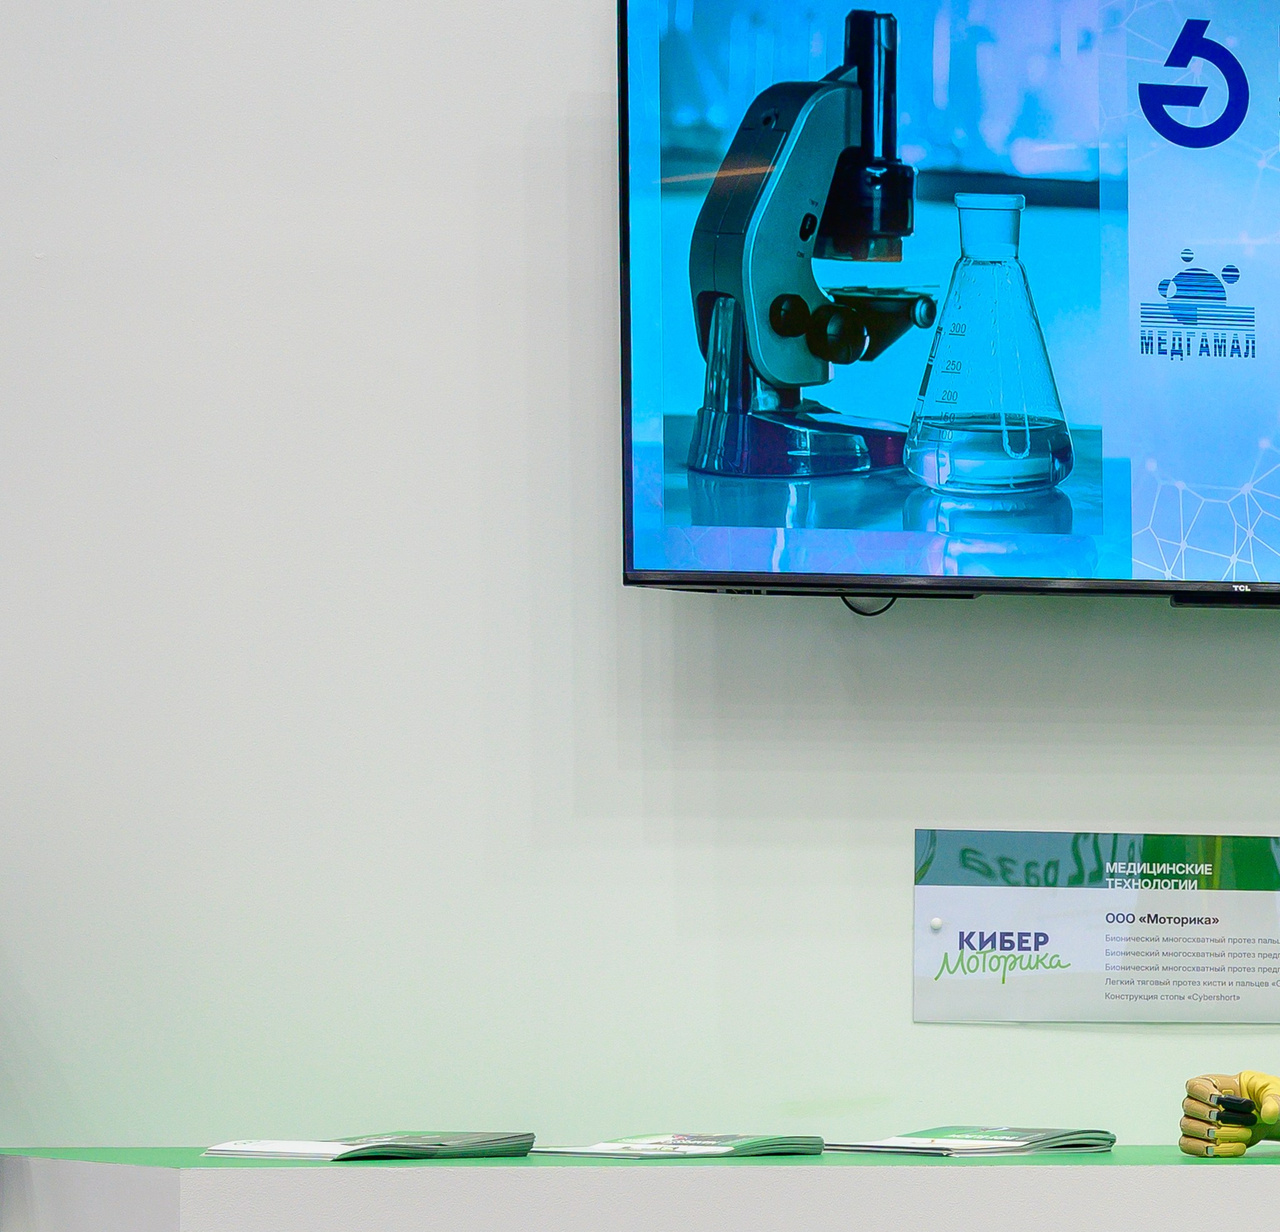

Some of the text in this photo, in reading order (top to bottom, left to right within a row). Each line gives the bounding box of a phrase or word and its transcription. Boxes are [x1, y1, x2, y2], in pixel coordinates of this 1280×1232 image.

[950, 322, 967, 334] 300
[1140, 330, 1256, 361] МЕДГАМАЛ
[945, 360, 962, 371] 250
[941, 390, 959, 401] 200
[937, 429, 954, 440] 100
[1232, 584, 1251, 592] TCL
[1105, 861, 1213, 876] МЕДИЦИНСКИЕ
[1105, 878, 1198, 891] ТЕХНОЛОГИИ
[1105, 912, 1220, 927] ООО «Моторика»
[958, 931, 1050, 951] КИБЕР
[1105, 934, 1160, 943] Бионический
[1162, 936, 1226, 945] многосхватный
[1227, 937, 1256, 945] протез
[1105, 948, 1160, 957] Бионический
[1162, 950, 1226, 959] многосхватный
[1227, 951, 1256, 960] протез
[934, 948, 1072, 985] Моторика
[1105, 963, 1160, 972] Бионический
[1161, 965, 1226, 974] многосхватный
[1227, 966, 1256, 975] протез
[1104, 977, 1135, 987] Легкий
[1136, 979, 1171, 987] тяговый
[1172, 980, 1201, 988] протез
[1202, 980, 1227, 988] кисти
[1235, 980, 1269, 988] пальцев
[1104, 992, 1159, 1001] Конструкция
[1187, 993, 1241, 1002] «Cybershort»
